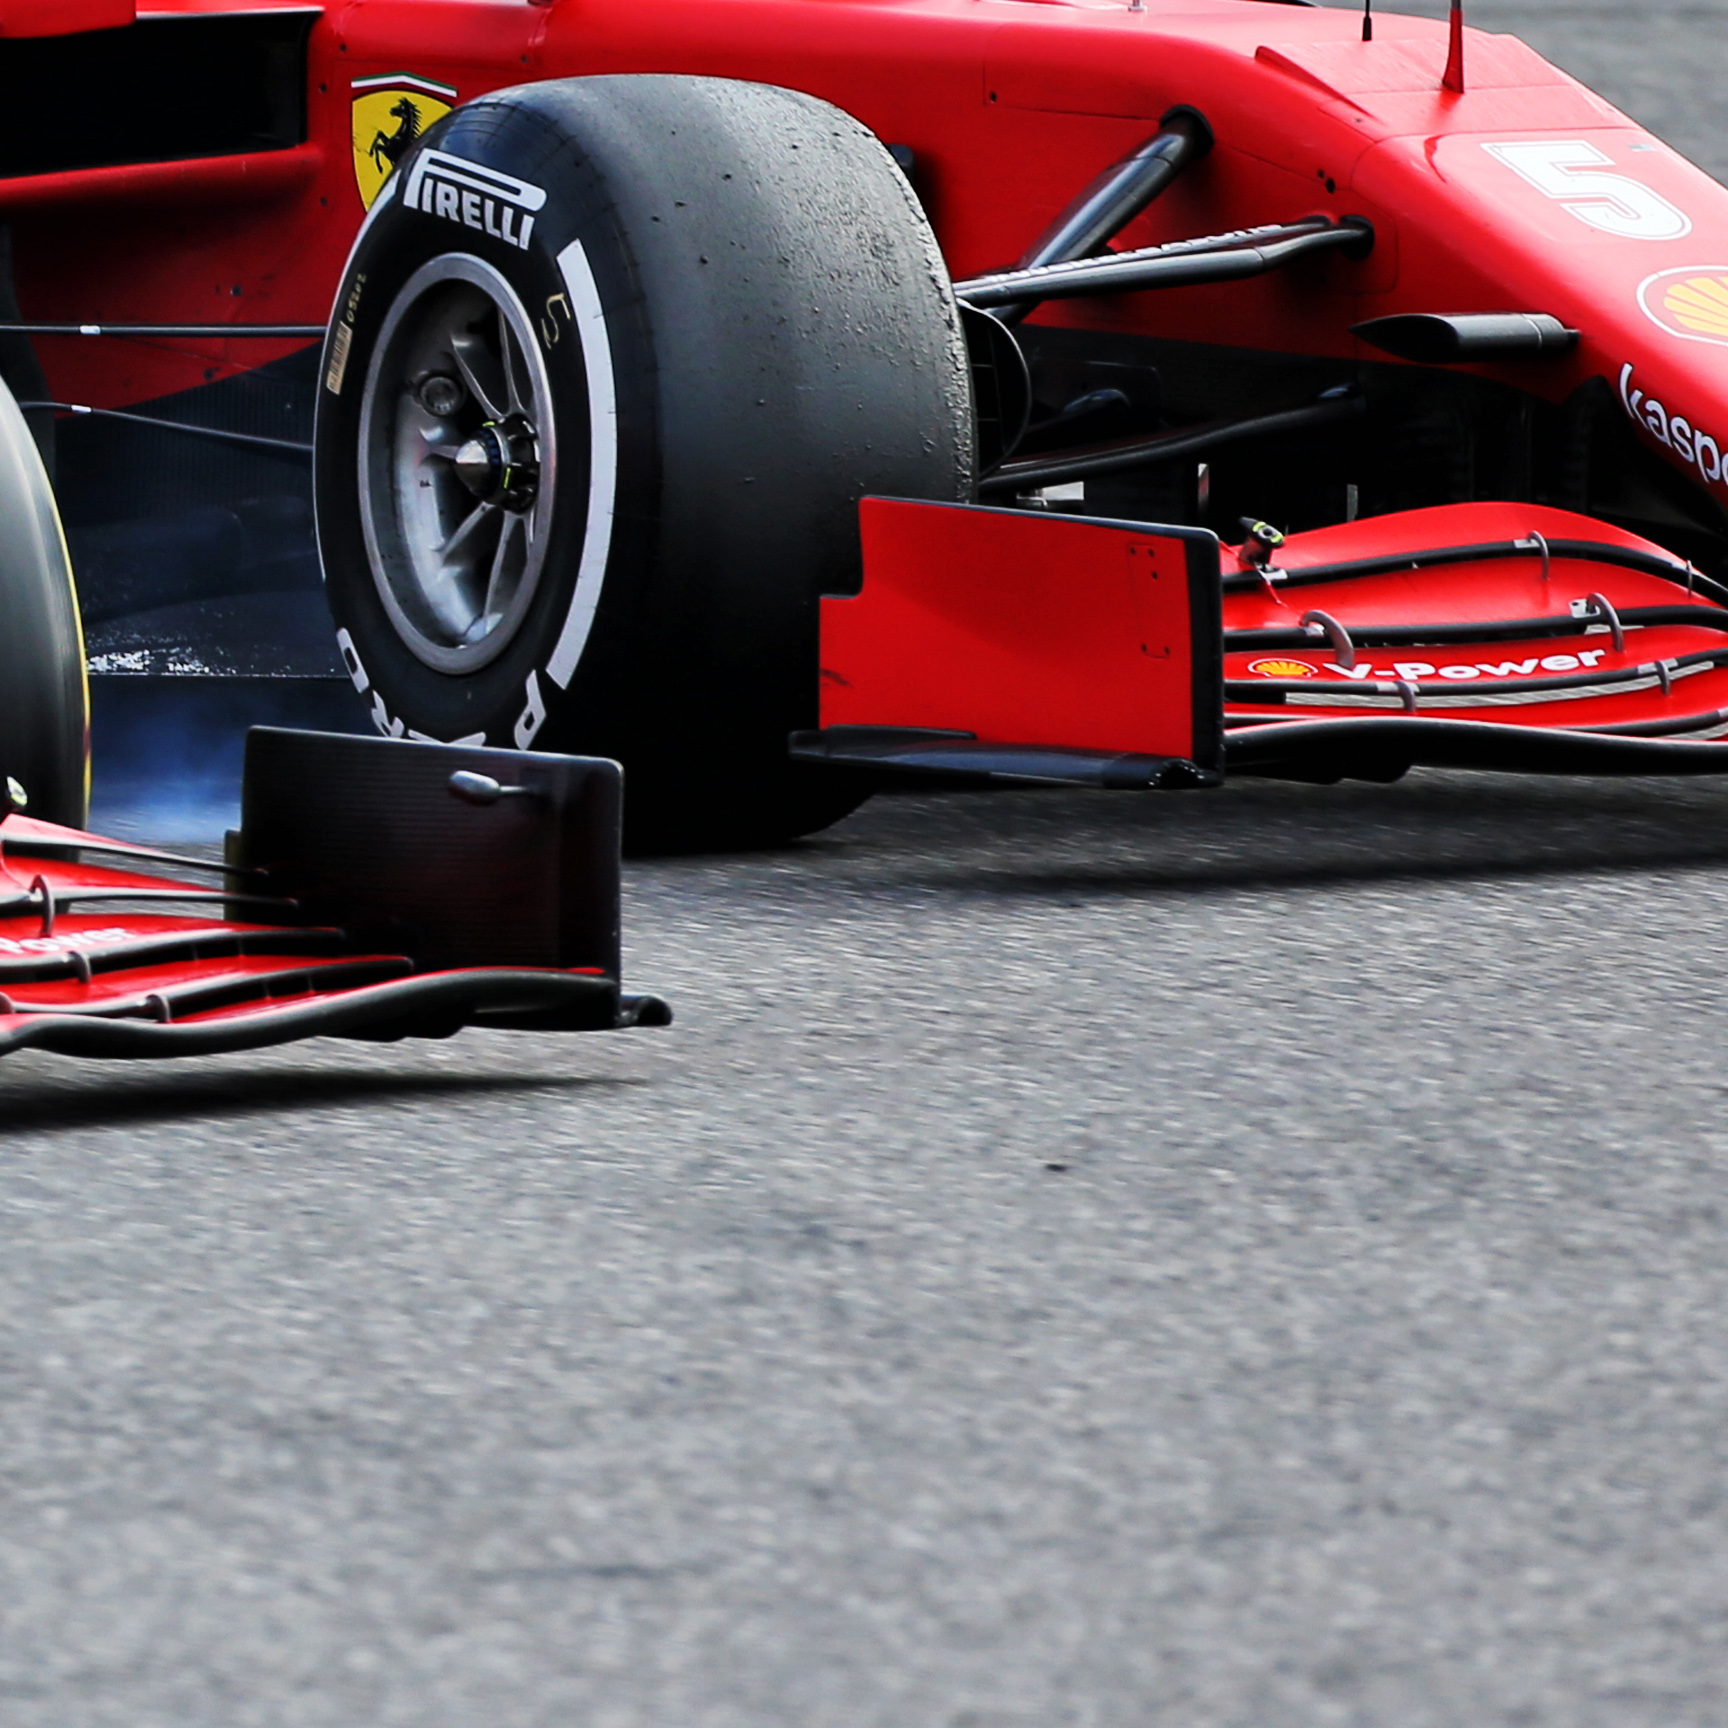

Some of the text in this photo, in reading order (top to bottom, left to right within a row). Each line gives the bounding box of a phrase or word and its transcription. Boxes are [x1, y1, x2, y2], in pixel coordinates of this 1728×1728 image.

[403, 148, 547, 251] PIRELLI
[1479, 139, 1693, 241] 5
[1323, 648, 1606, 681] V-Power
